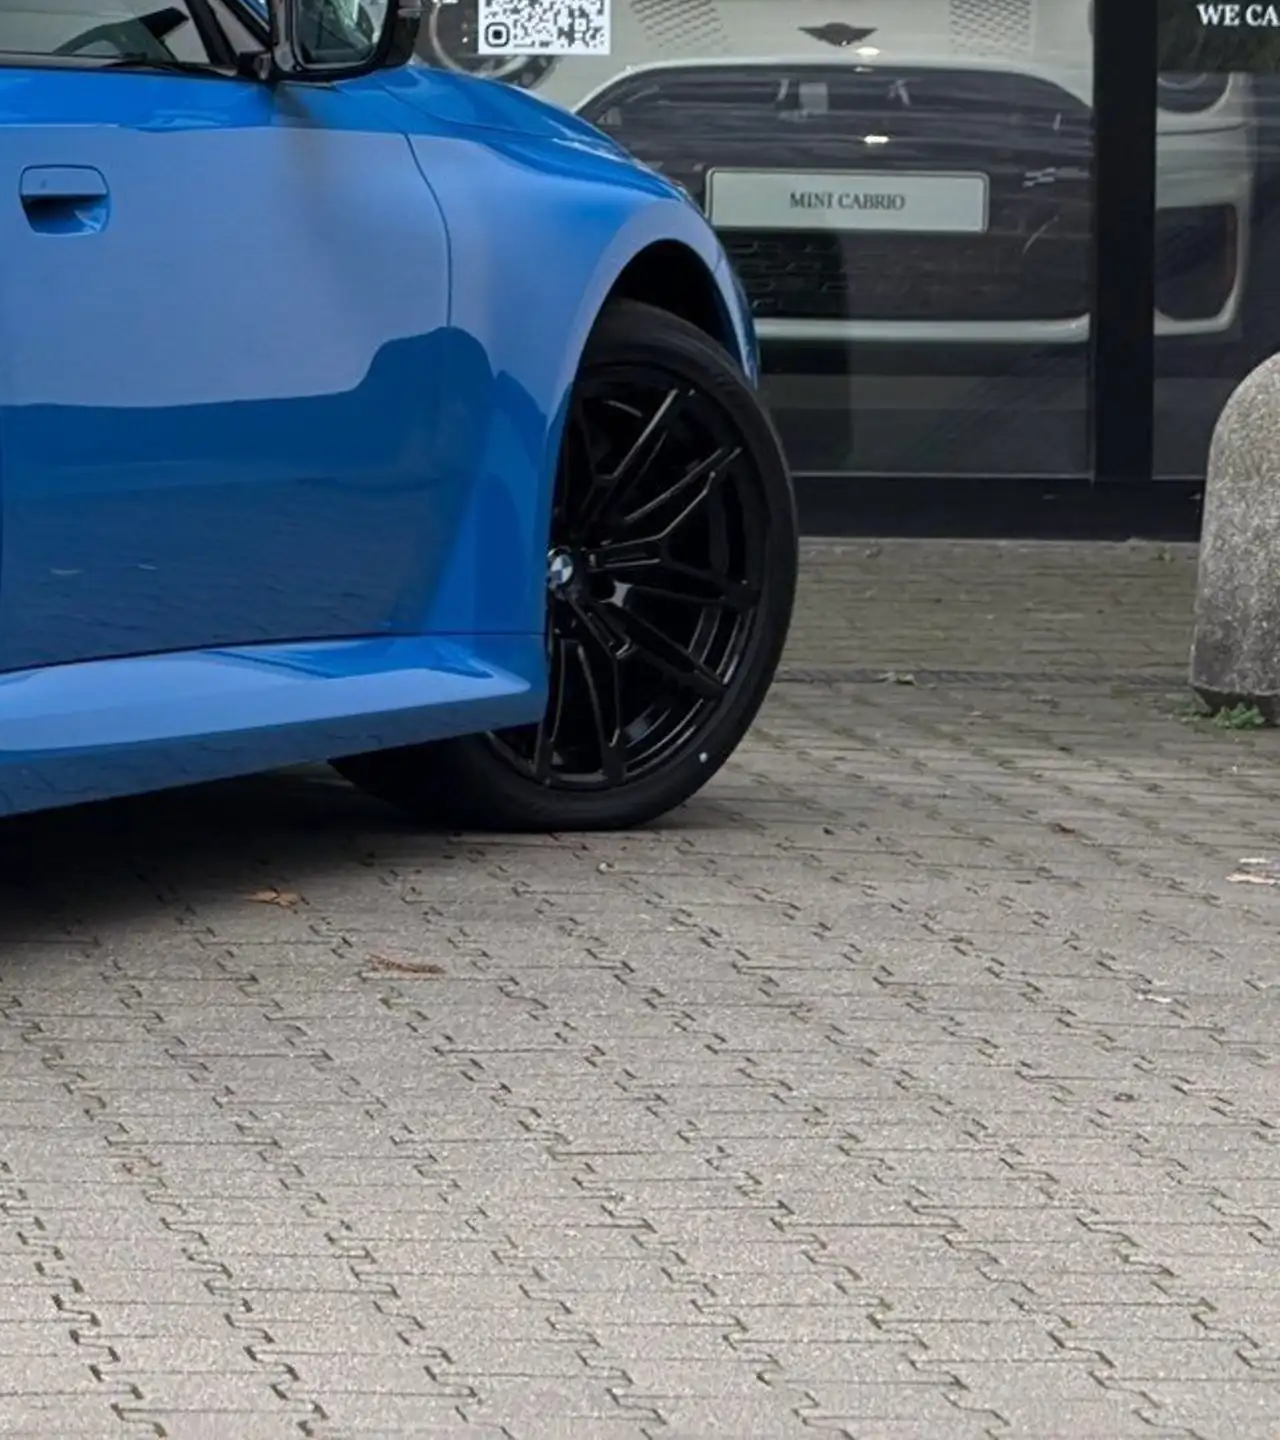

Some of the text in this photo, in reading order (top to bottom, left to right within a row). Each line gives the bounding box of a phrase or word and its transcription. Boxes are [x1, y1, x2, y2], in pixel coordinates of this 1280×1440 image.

[1195, 4, 1241, 27] WE
[789, 191, 907, 212] MINI CABRIO
